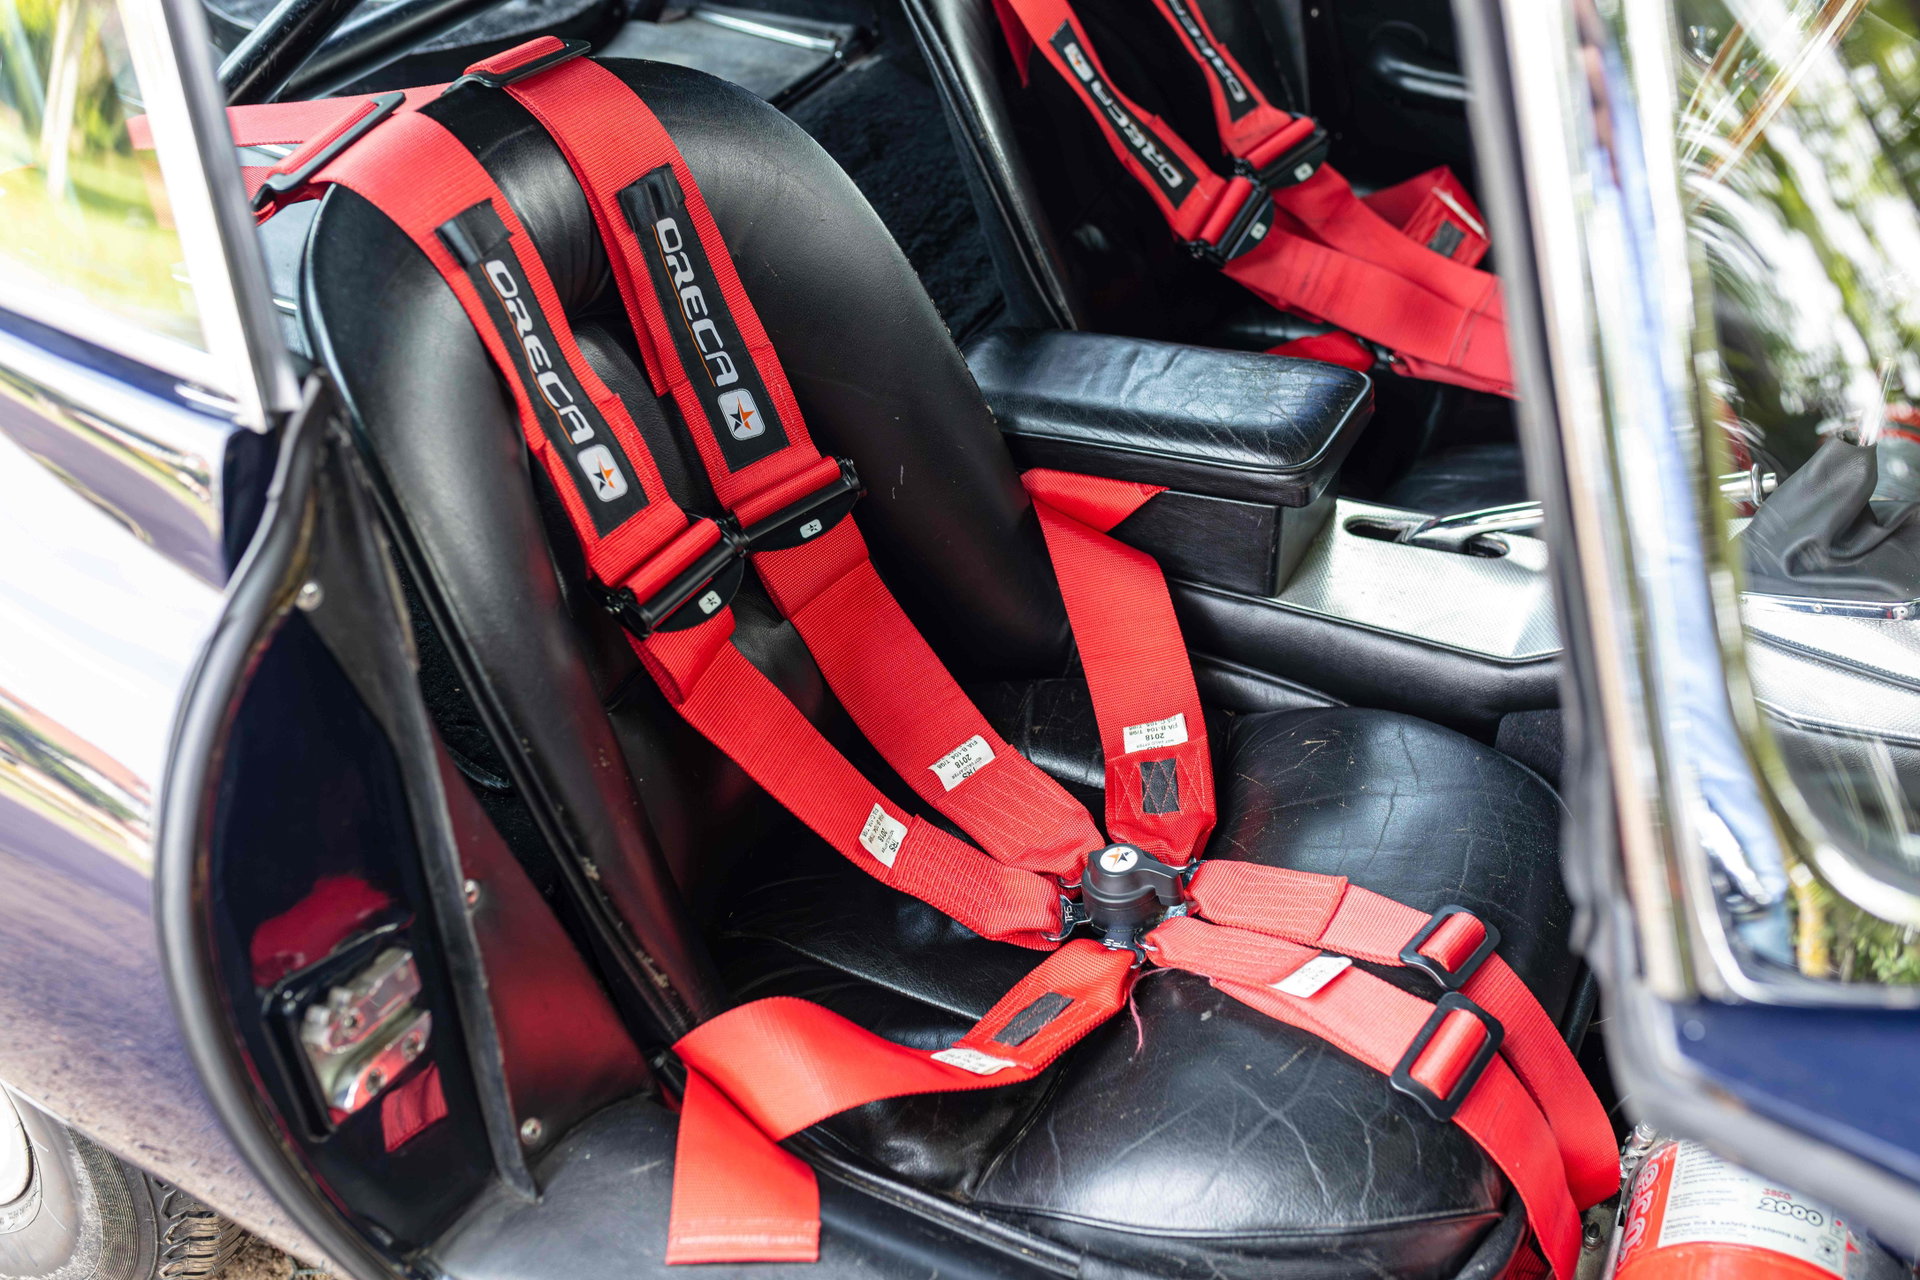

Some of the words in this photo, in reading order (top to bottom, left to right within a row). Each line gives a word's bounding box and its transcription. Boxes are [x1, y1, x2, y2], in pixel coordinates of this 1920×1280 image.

[1091, 80, 1183, 188] ORECA
[656, 217, 738, 386] ORECA
[486, 260, 594, 444] ORECA
[954, 753, 972, 769] 2018
[1145, 732, 1165, 741] 2018
[1757, 1197, 1824, 1227] 2000
